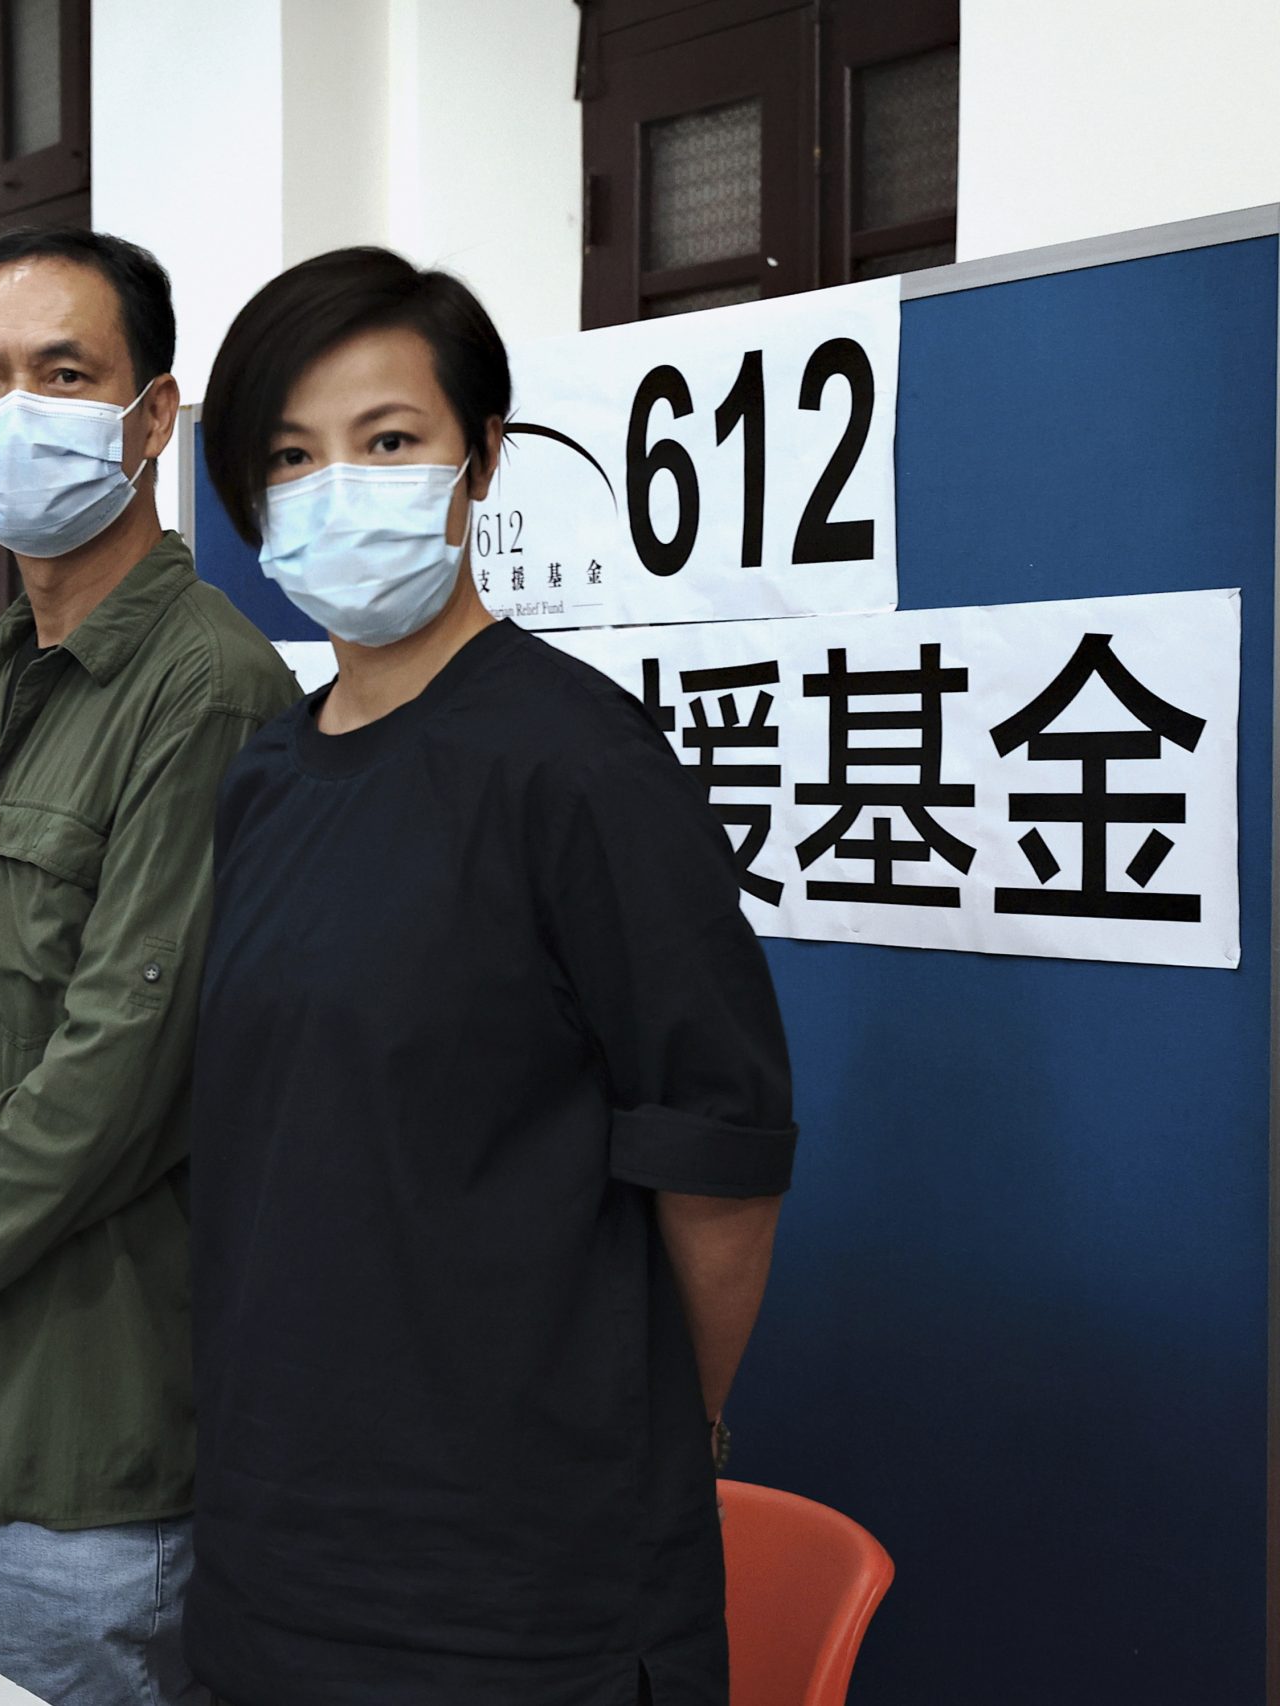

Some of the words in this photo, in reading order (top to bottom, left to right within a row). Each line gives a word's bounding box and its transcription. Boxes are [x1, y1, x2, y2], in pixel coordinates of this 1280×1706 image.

[626, 337, 875, 577] 612
[476, 510, 524, 557] 612
[478, 559, 603, 593] 支援基金
[516, 602, 540, 617] Relief
[542, 600, 565, 615] Fund
